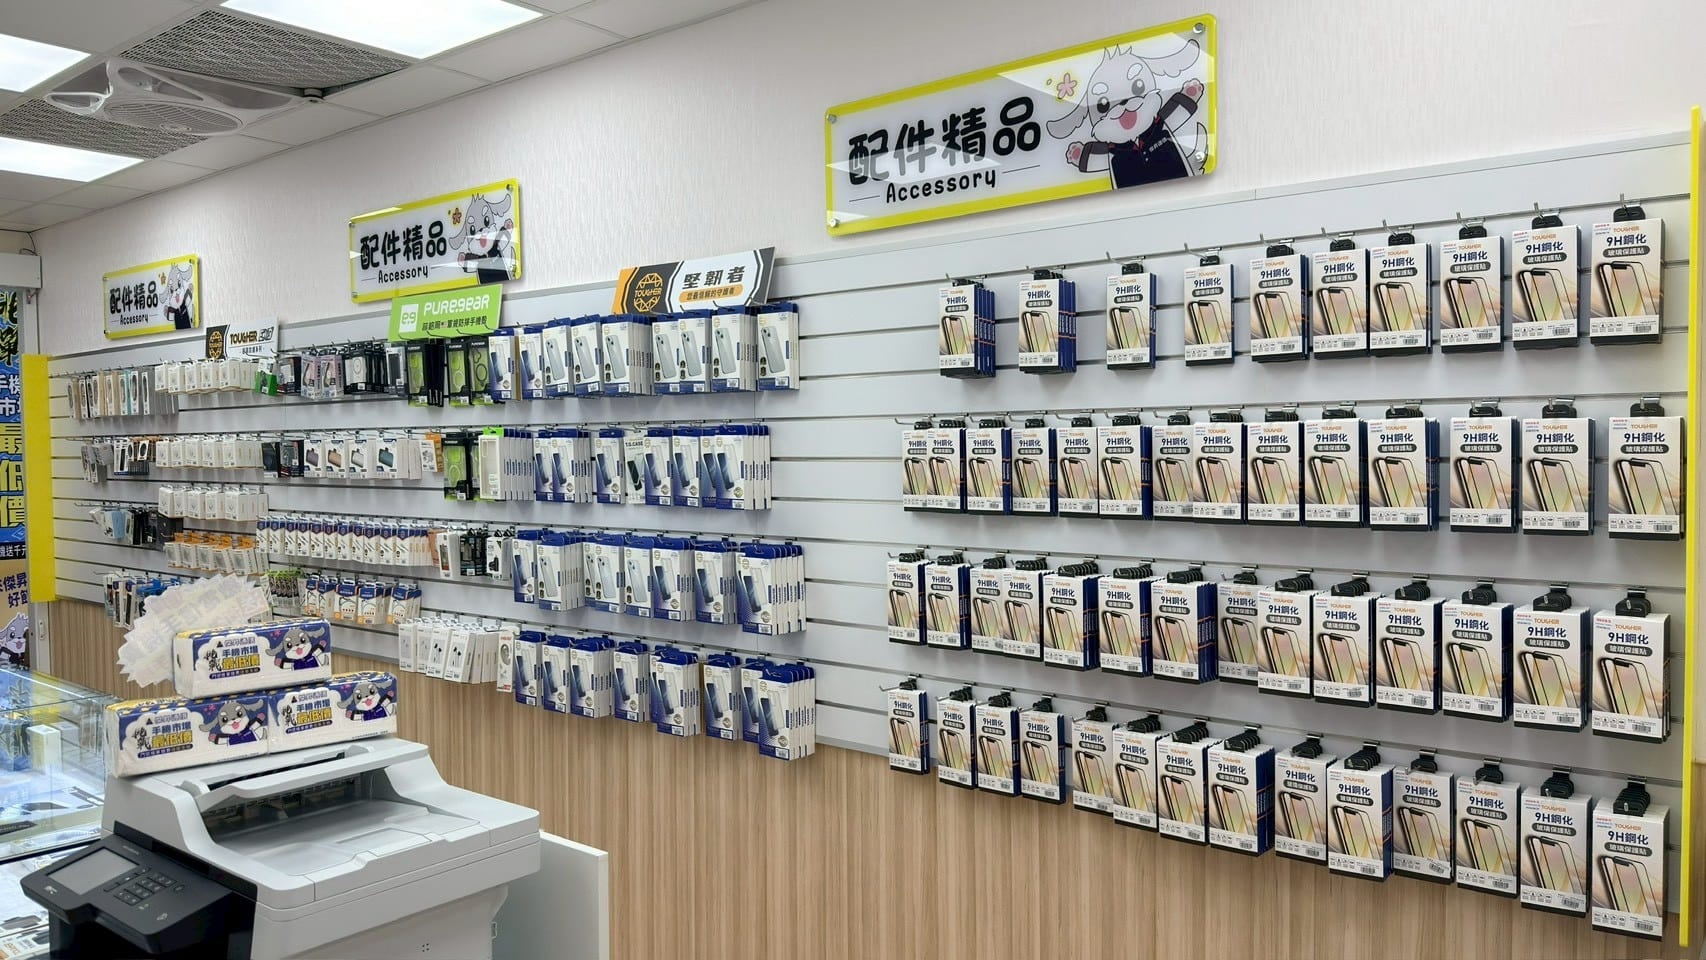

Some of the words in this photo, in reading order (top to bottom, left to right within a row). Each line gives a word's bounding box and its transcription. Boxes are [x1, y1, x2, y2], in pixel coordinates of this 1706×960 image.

[849, 97, 1041, 185] 配件精品
[886, 169, 997, 204] Accessory
[1532, 233, 1557, 241] TOUGHER
[1606, 233, 1647, 247] 9H鋼化
[360, 220, 448, 270] 配件精品
[1526, 240, 1564, 254] 9H鋼化
[1607, 246, 1645, 257] 玻璃保護貼
[1382, 256, 1415, 268] 9H鋼化
[1453, 250, 1488, 263] 9H鋼化
[1527, 253, 1562, 264] 玻璃保護貼
[378, 265, 429, 284] Accessory
[109, 282, 159, 314] 配件精品
[634, 287, 662, 298] TOUGHER
[120, 313, 149, 326] Accessory
[230, 331, 258, 345] TOUGHER
[1316, 433, 1348, 442] 9H鋼化
[1380, 433, 1414, 442] 9H鋼化
[1463, 432, 1499, 442] 9H鋼化
[1536, 433, 1575, 443] 9H鋼化
[1624, 432, 1666, 442] 9H鋼化
[1537, 445, 1573, 453] 玻璃保護貼
[1625, 445, 1663, 453] 玻璃保護貼
[1325, 610, 1357, 621] 9H鋼化
[1388, 614, 1422, 626] 9H鋼化
[1455, 618, 1490, 631] 9H鋼化
[1615, 623, 1642, 631] TOUGHER
[1528, 625, 1567, 638] 9H鋼化
[1608, 631, 1649, 645] 9H鋼化
[1529, 638, 1565, 648] 玻璃保護貼
[1609, 644, 1647, 656] 玻璃保護貼
[1339, 783, 1371, 796] 9H鋼化
[1404, 783, 1438, 797] 9H鋼化
[1469, 795, 1505, 809] 9H鋼化
[1541, 804, 1567, 812] TOUGHER
[1535, 811, 1574, 826] 9H鋼化
[1536, 823, 1572, 836] 玻璃保護貼
[1614, 823, 1642, 831] TOUGHER
[1608, 830, 1649, 845] 9H鋼化
[1609, 843, 1647, 856] 玻璃保護貼
